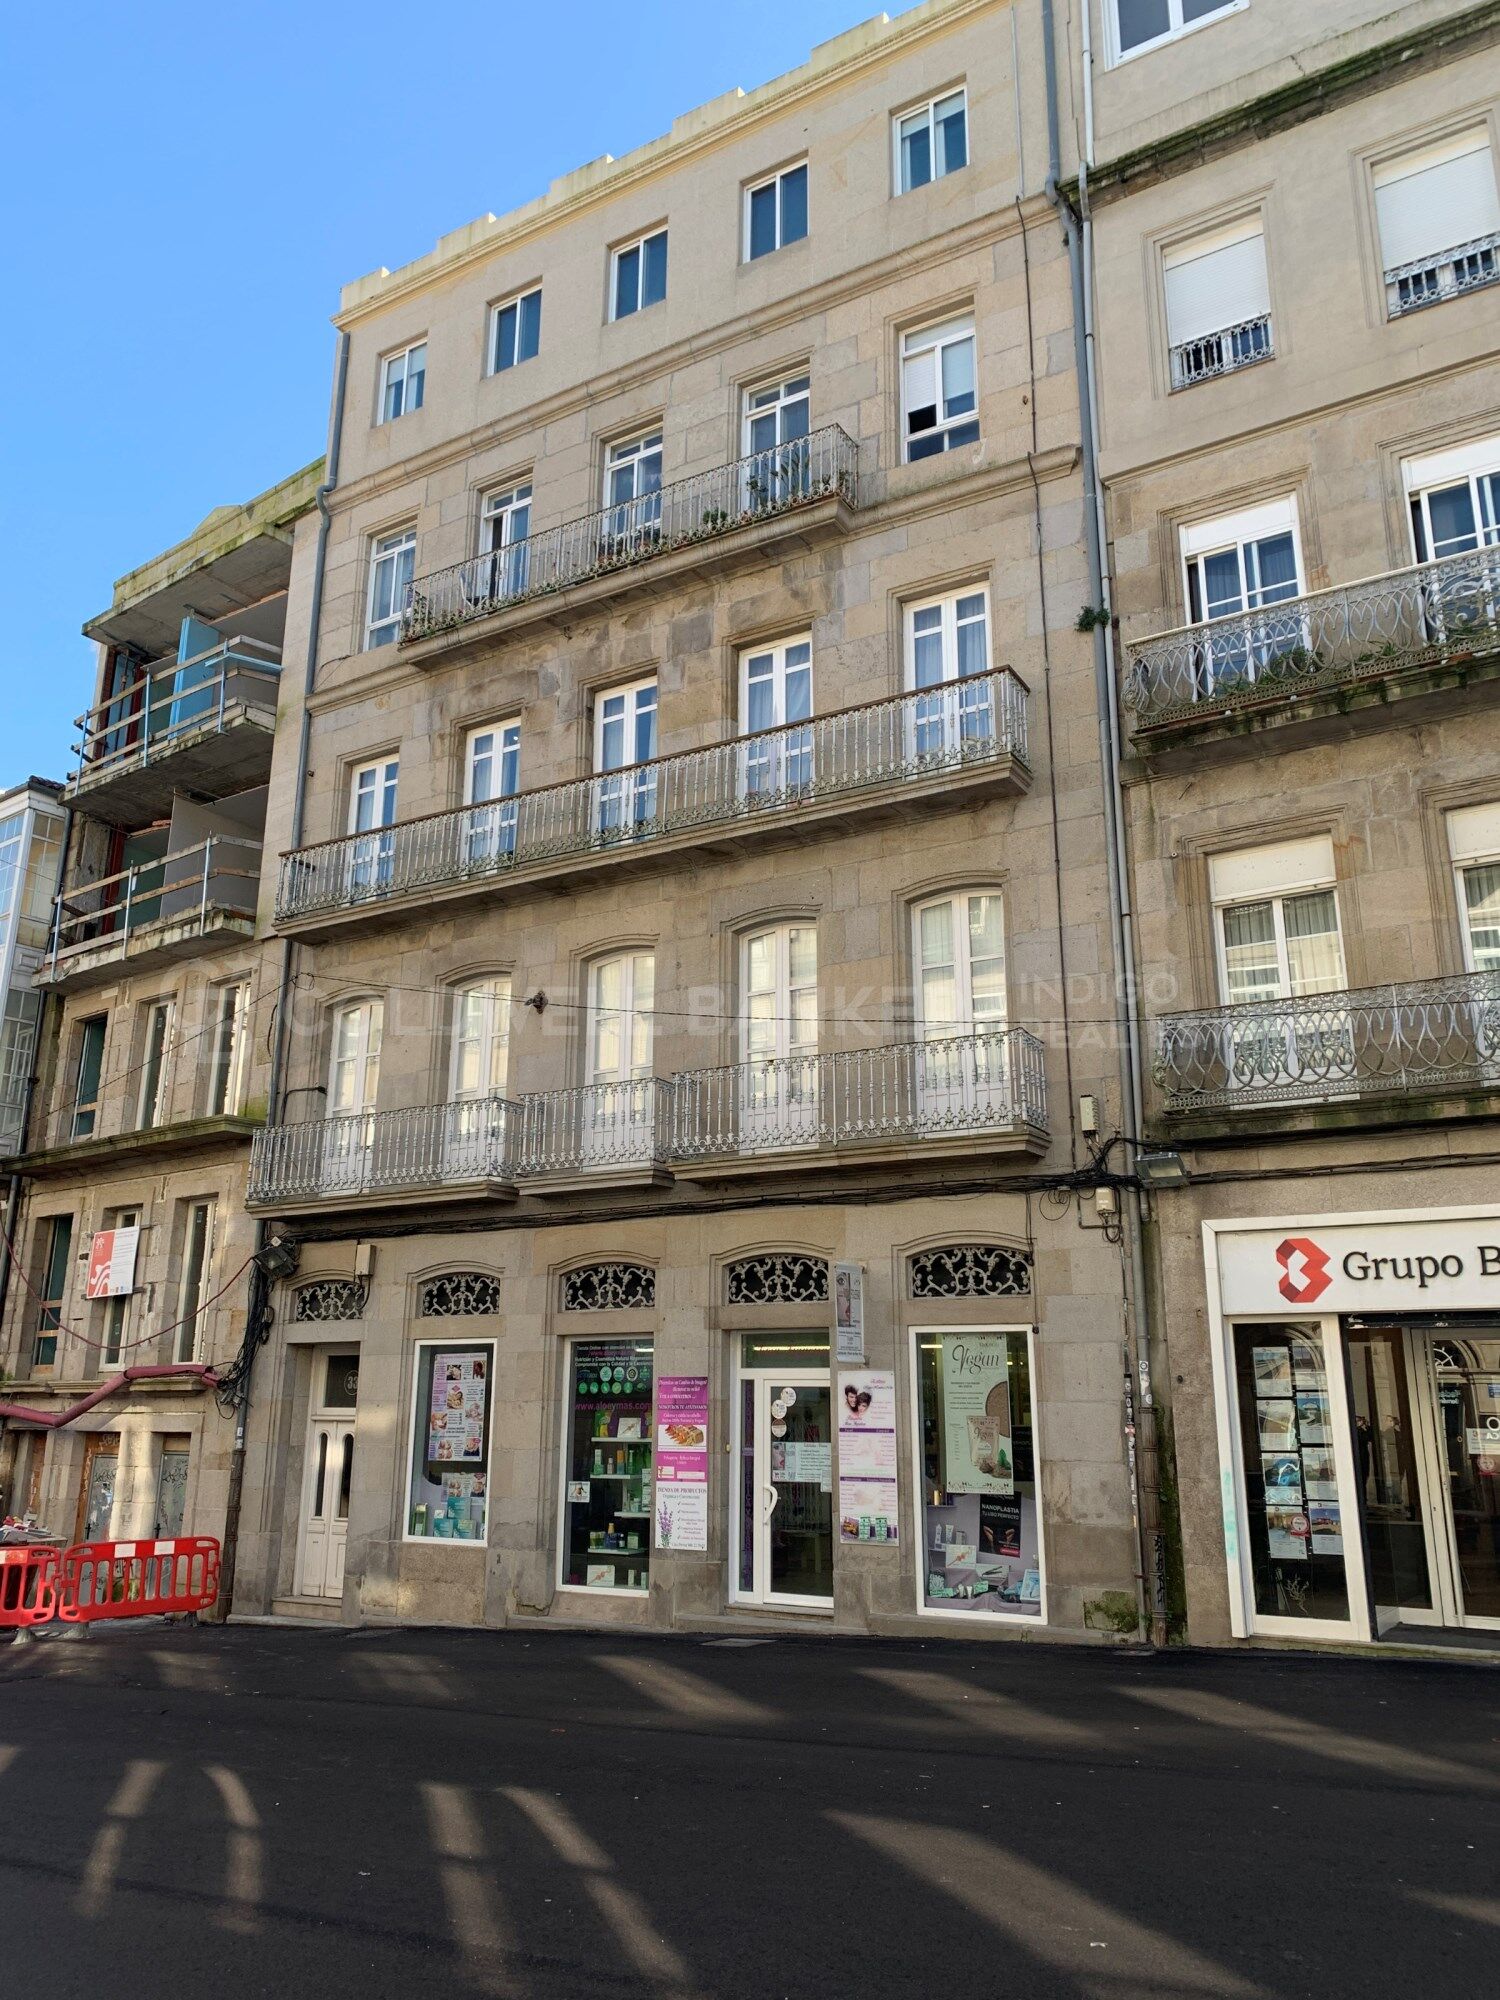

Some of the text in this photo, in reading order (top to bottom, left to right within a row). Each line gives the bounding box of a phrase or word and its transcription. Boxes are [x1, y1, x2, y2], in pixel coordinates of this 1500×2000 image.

[1343, 1251, 1464, 1288] Grupo
[952, 1344, 999, 1375] Vegan
[347, 1376, 358, 1389] 33
[981, 1504, 1019, 1514] NANOPLASTIA
